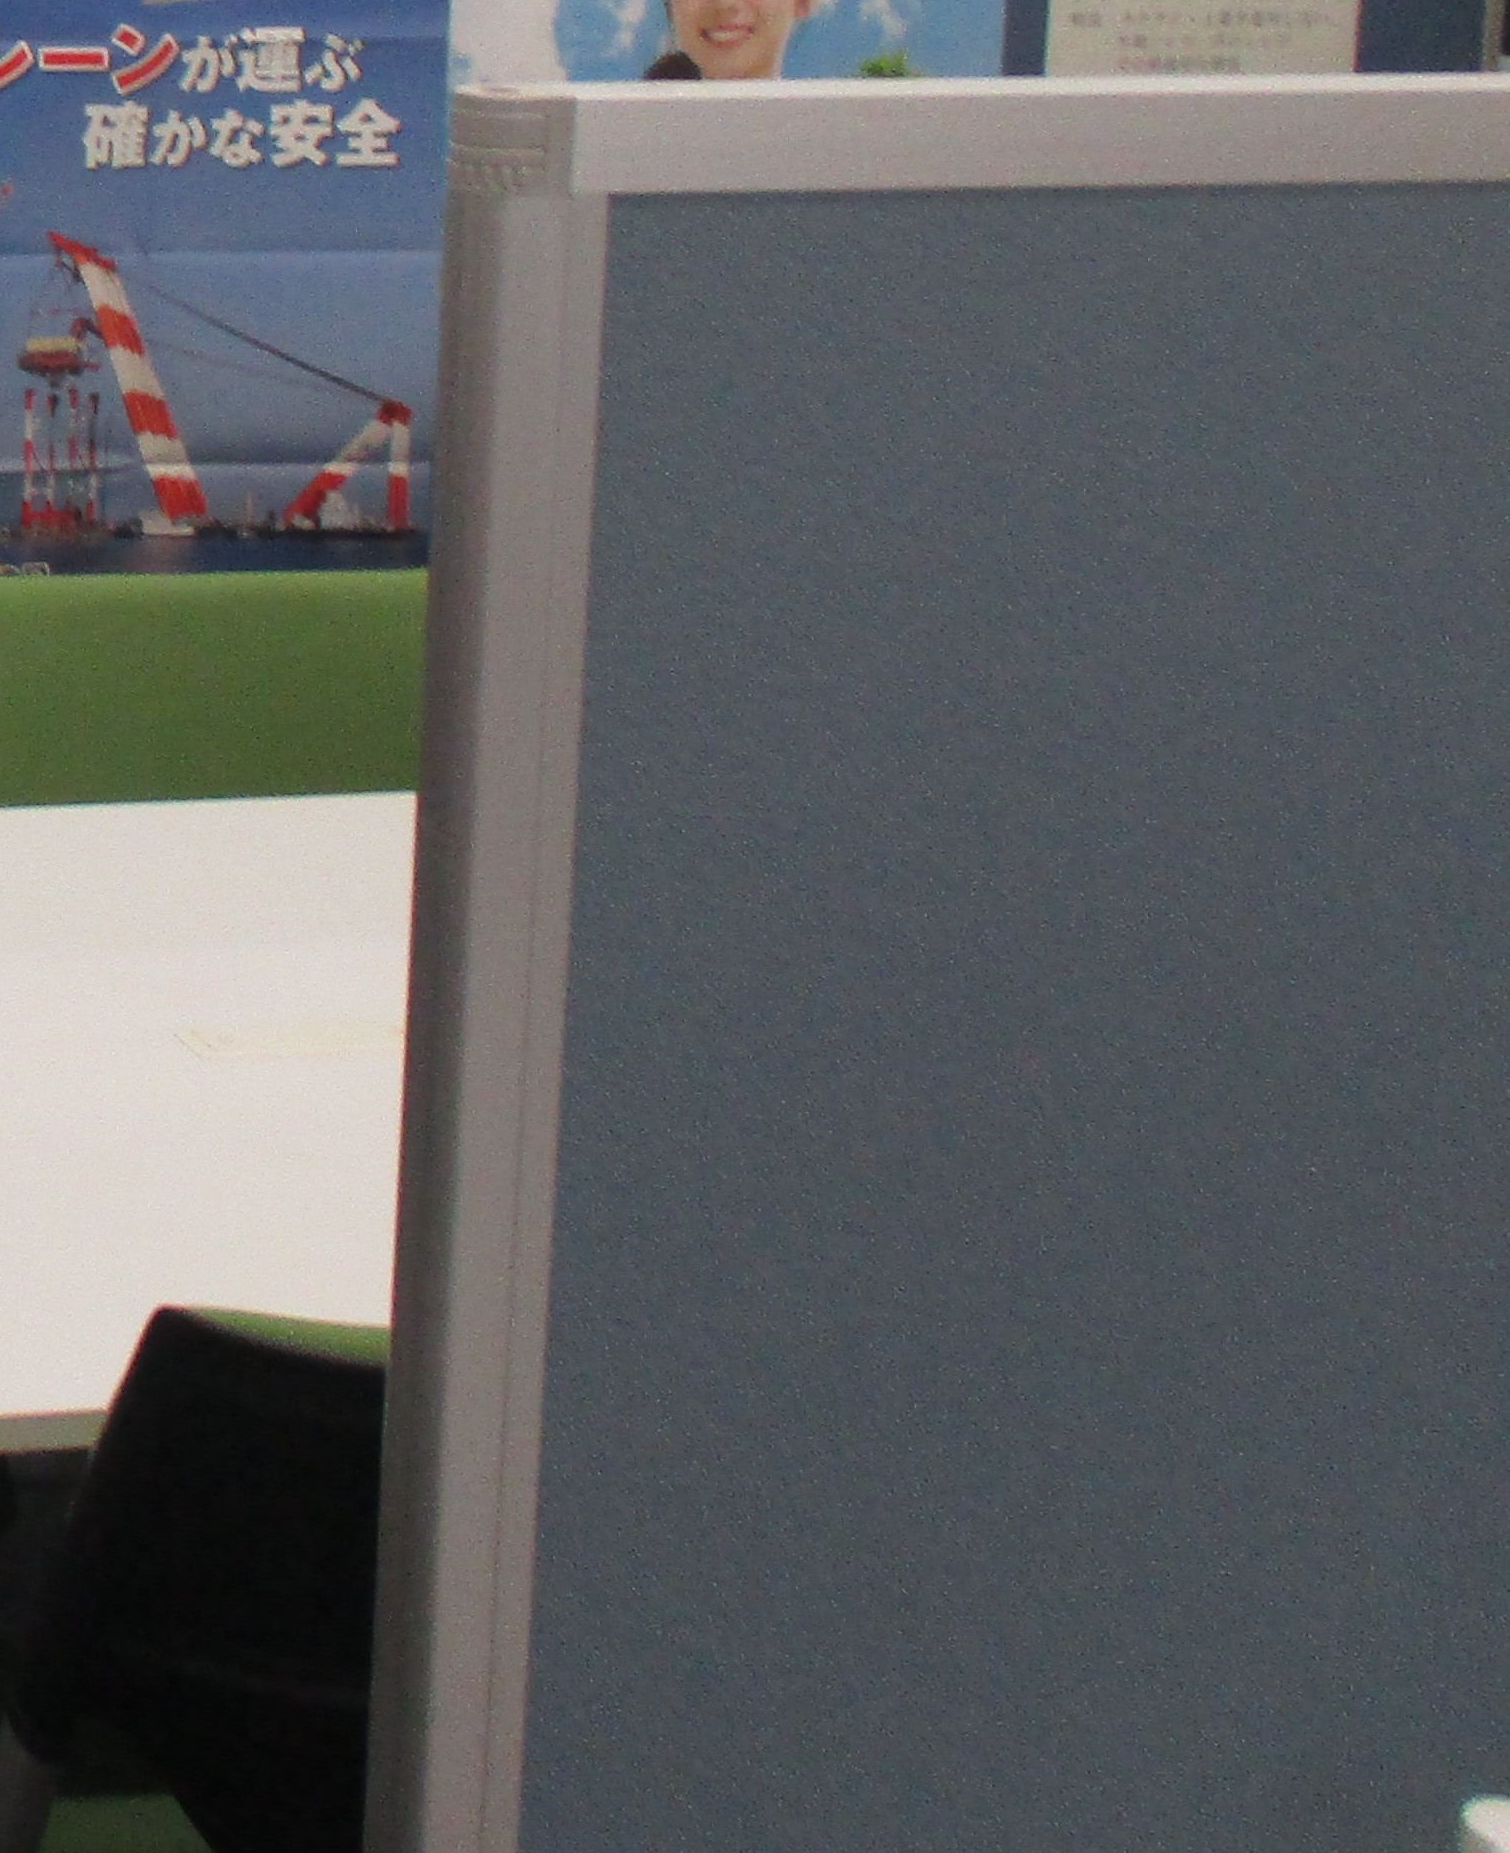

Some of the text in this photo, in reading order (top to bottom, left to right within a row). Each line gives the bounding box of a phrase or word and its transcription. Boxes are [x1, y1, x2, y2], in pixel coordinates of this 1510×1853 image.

[83, 98, 402, 170] 確かな安全
